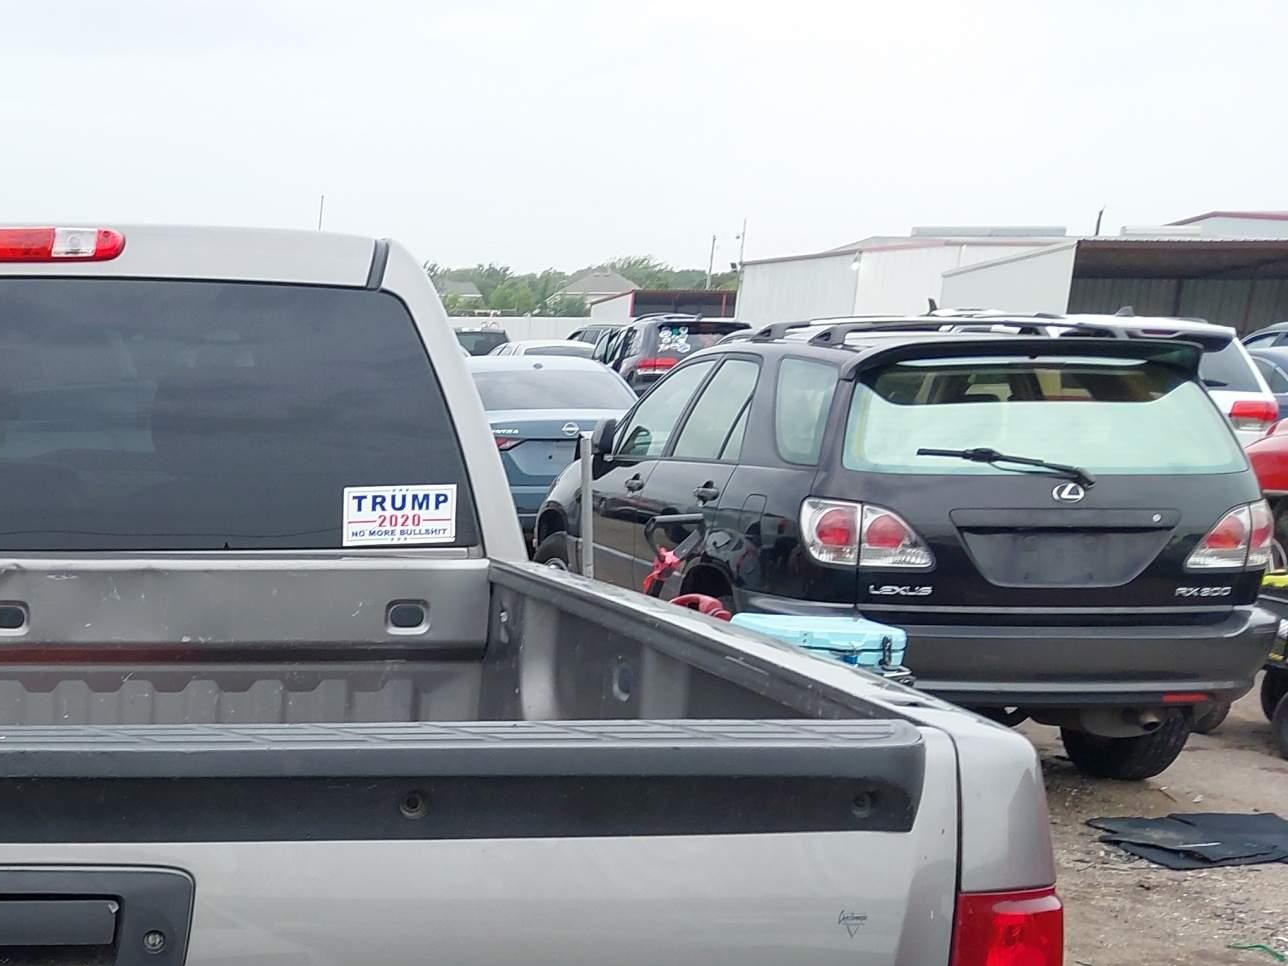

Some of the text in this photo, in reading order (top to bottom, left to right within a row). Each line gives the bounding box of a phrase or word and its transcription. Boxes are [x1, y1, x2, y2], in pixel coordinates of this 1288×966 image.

[352, 493, 449, 512] TRUMP
[378, 513, 421, 528] 2020
[351, 527, 449, 538] NO MORE BULLSHIT
[869, 584, 933, 596] LEXUS
